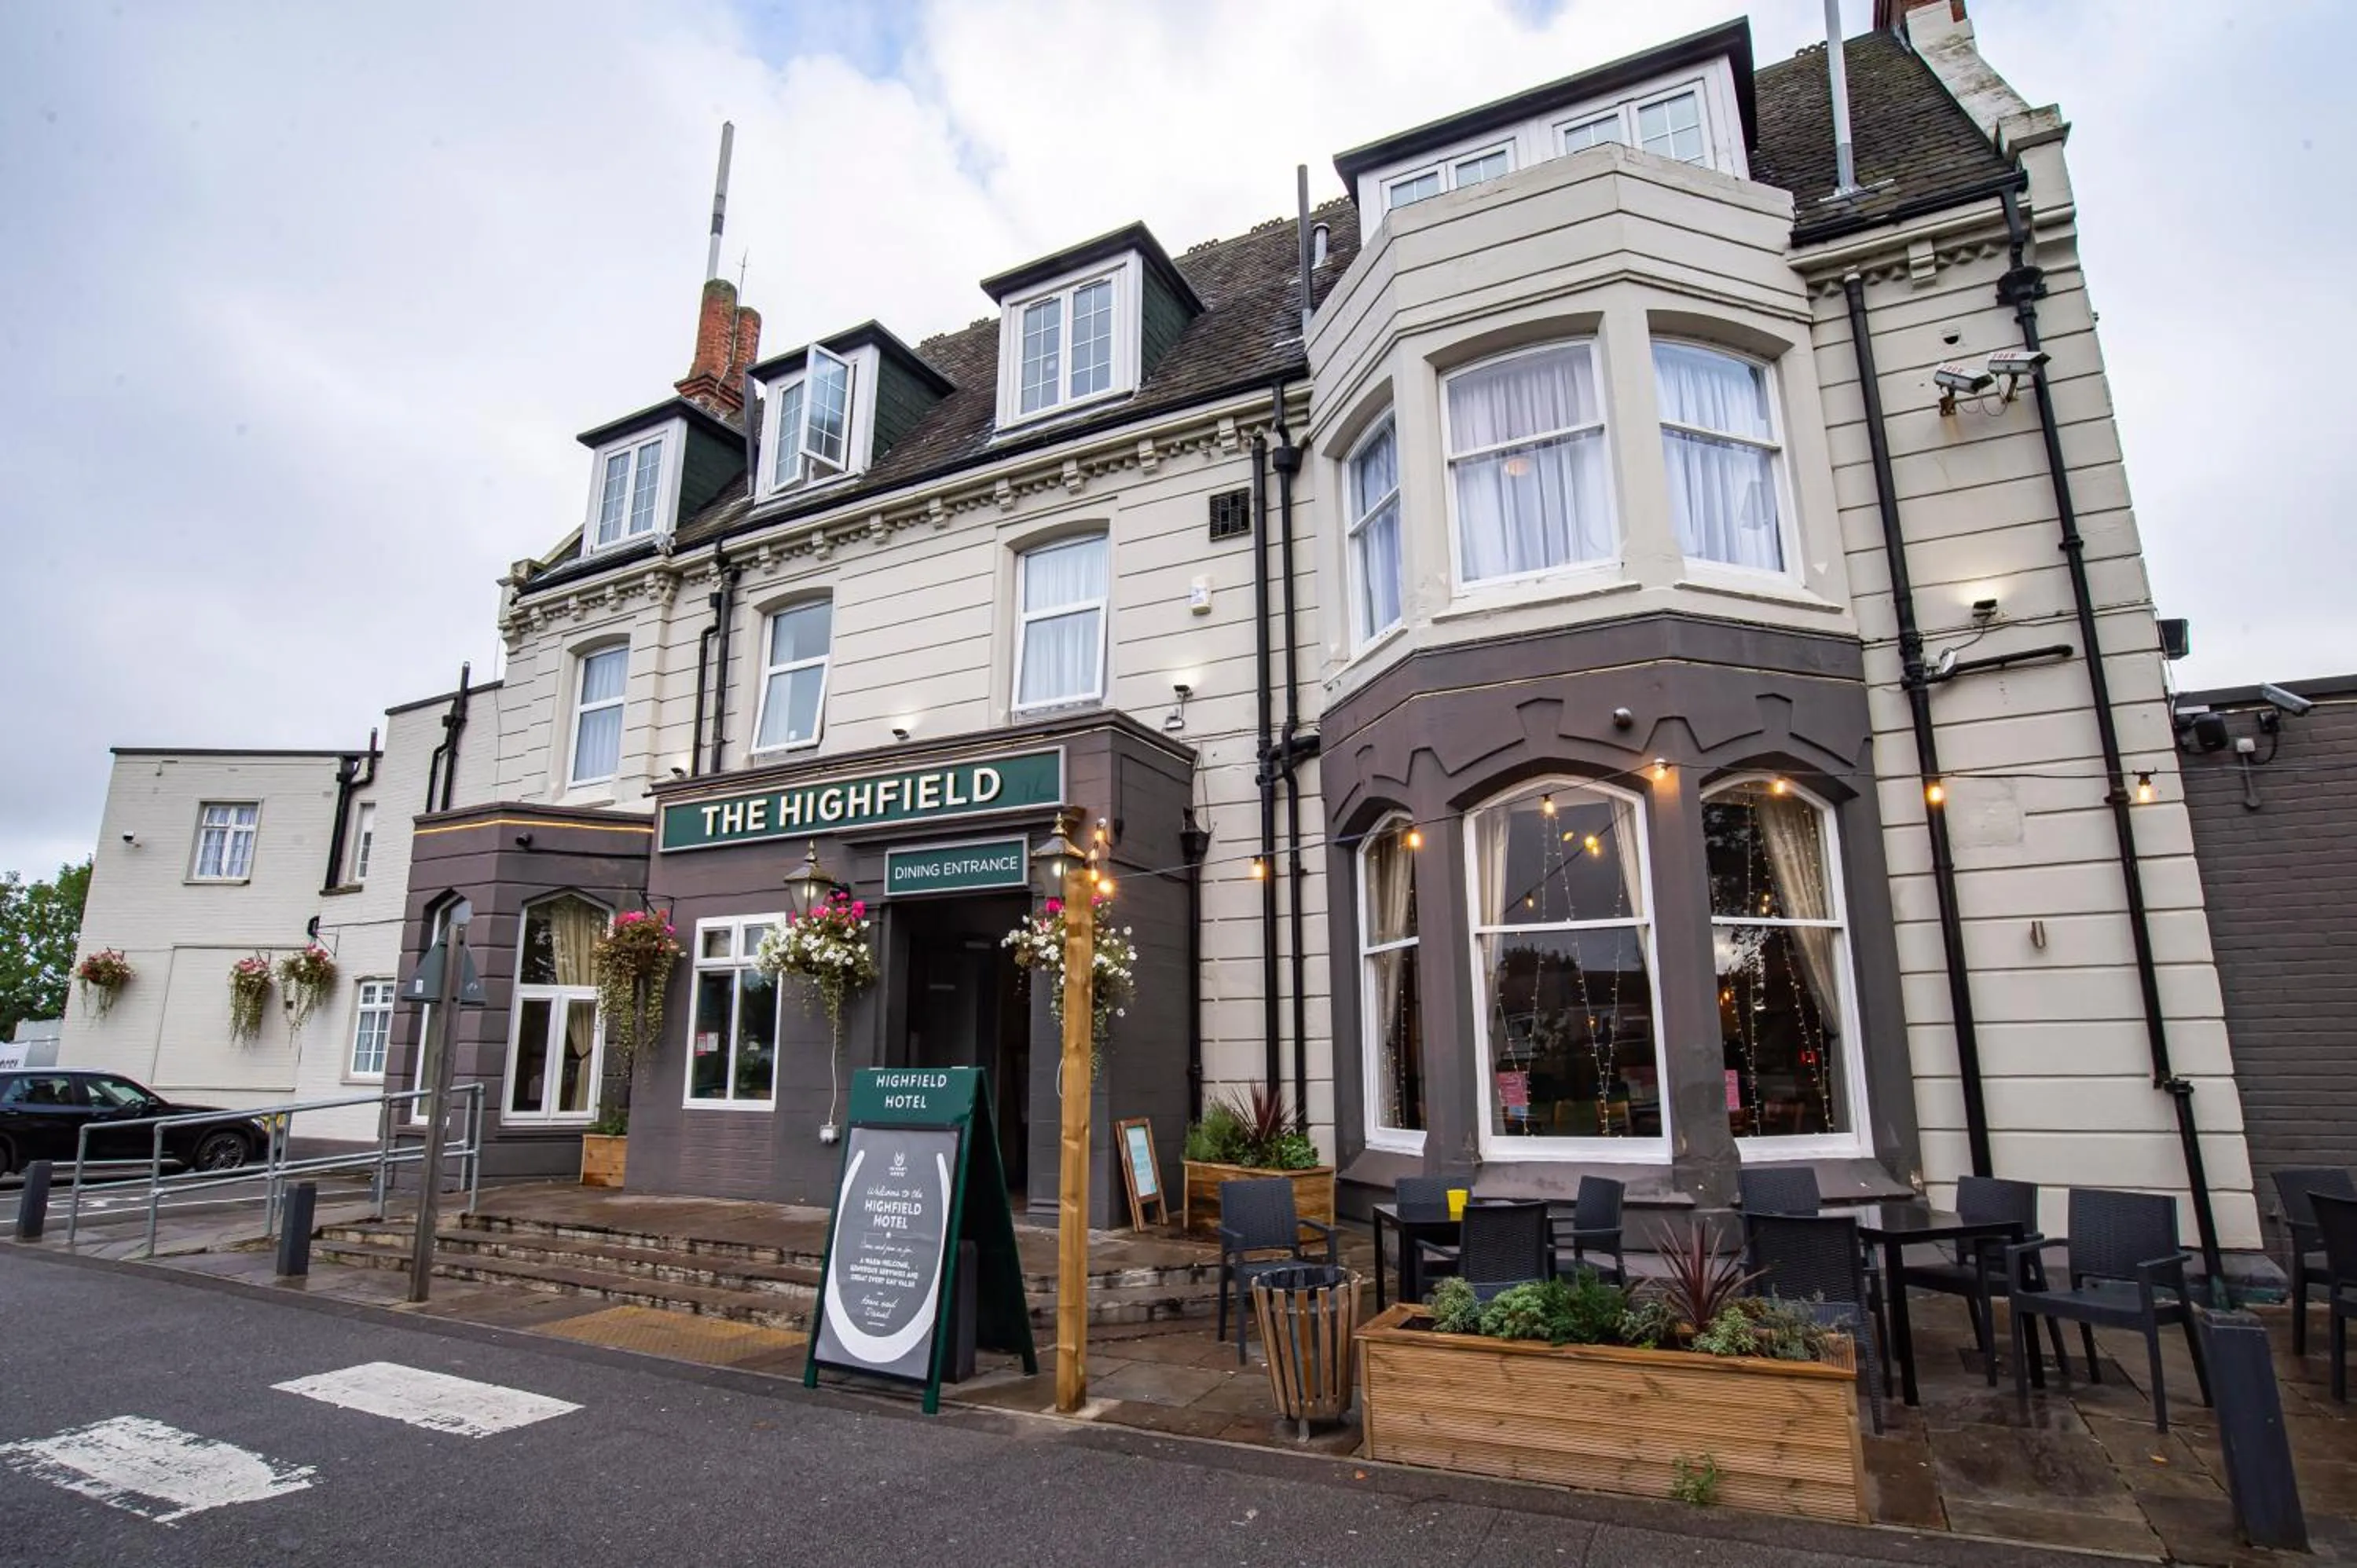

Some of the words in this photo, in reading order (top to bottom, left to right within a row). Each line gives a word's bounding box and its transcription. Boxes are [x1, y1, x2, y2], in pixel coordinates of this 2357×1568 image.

[701, 798, 769, 837] THE
[778, 767, 1003, 828] HIGHFIELD
[894, 863, 940, 881] DINING
[944, 855, 1019, 876] ENTRANCE
[875, 1074, 948, 1088] HIGHFIELD
[885, 1095, 927, 1109] HOTEL
[864, 1200, 922, 1215] HIGHFIELD
[873, 1214, 908, 1229] HOTEL
